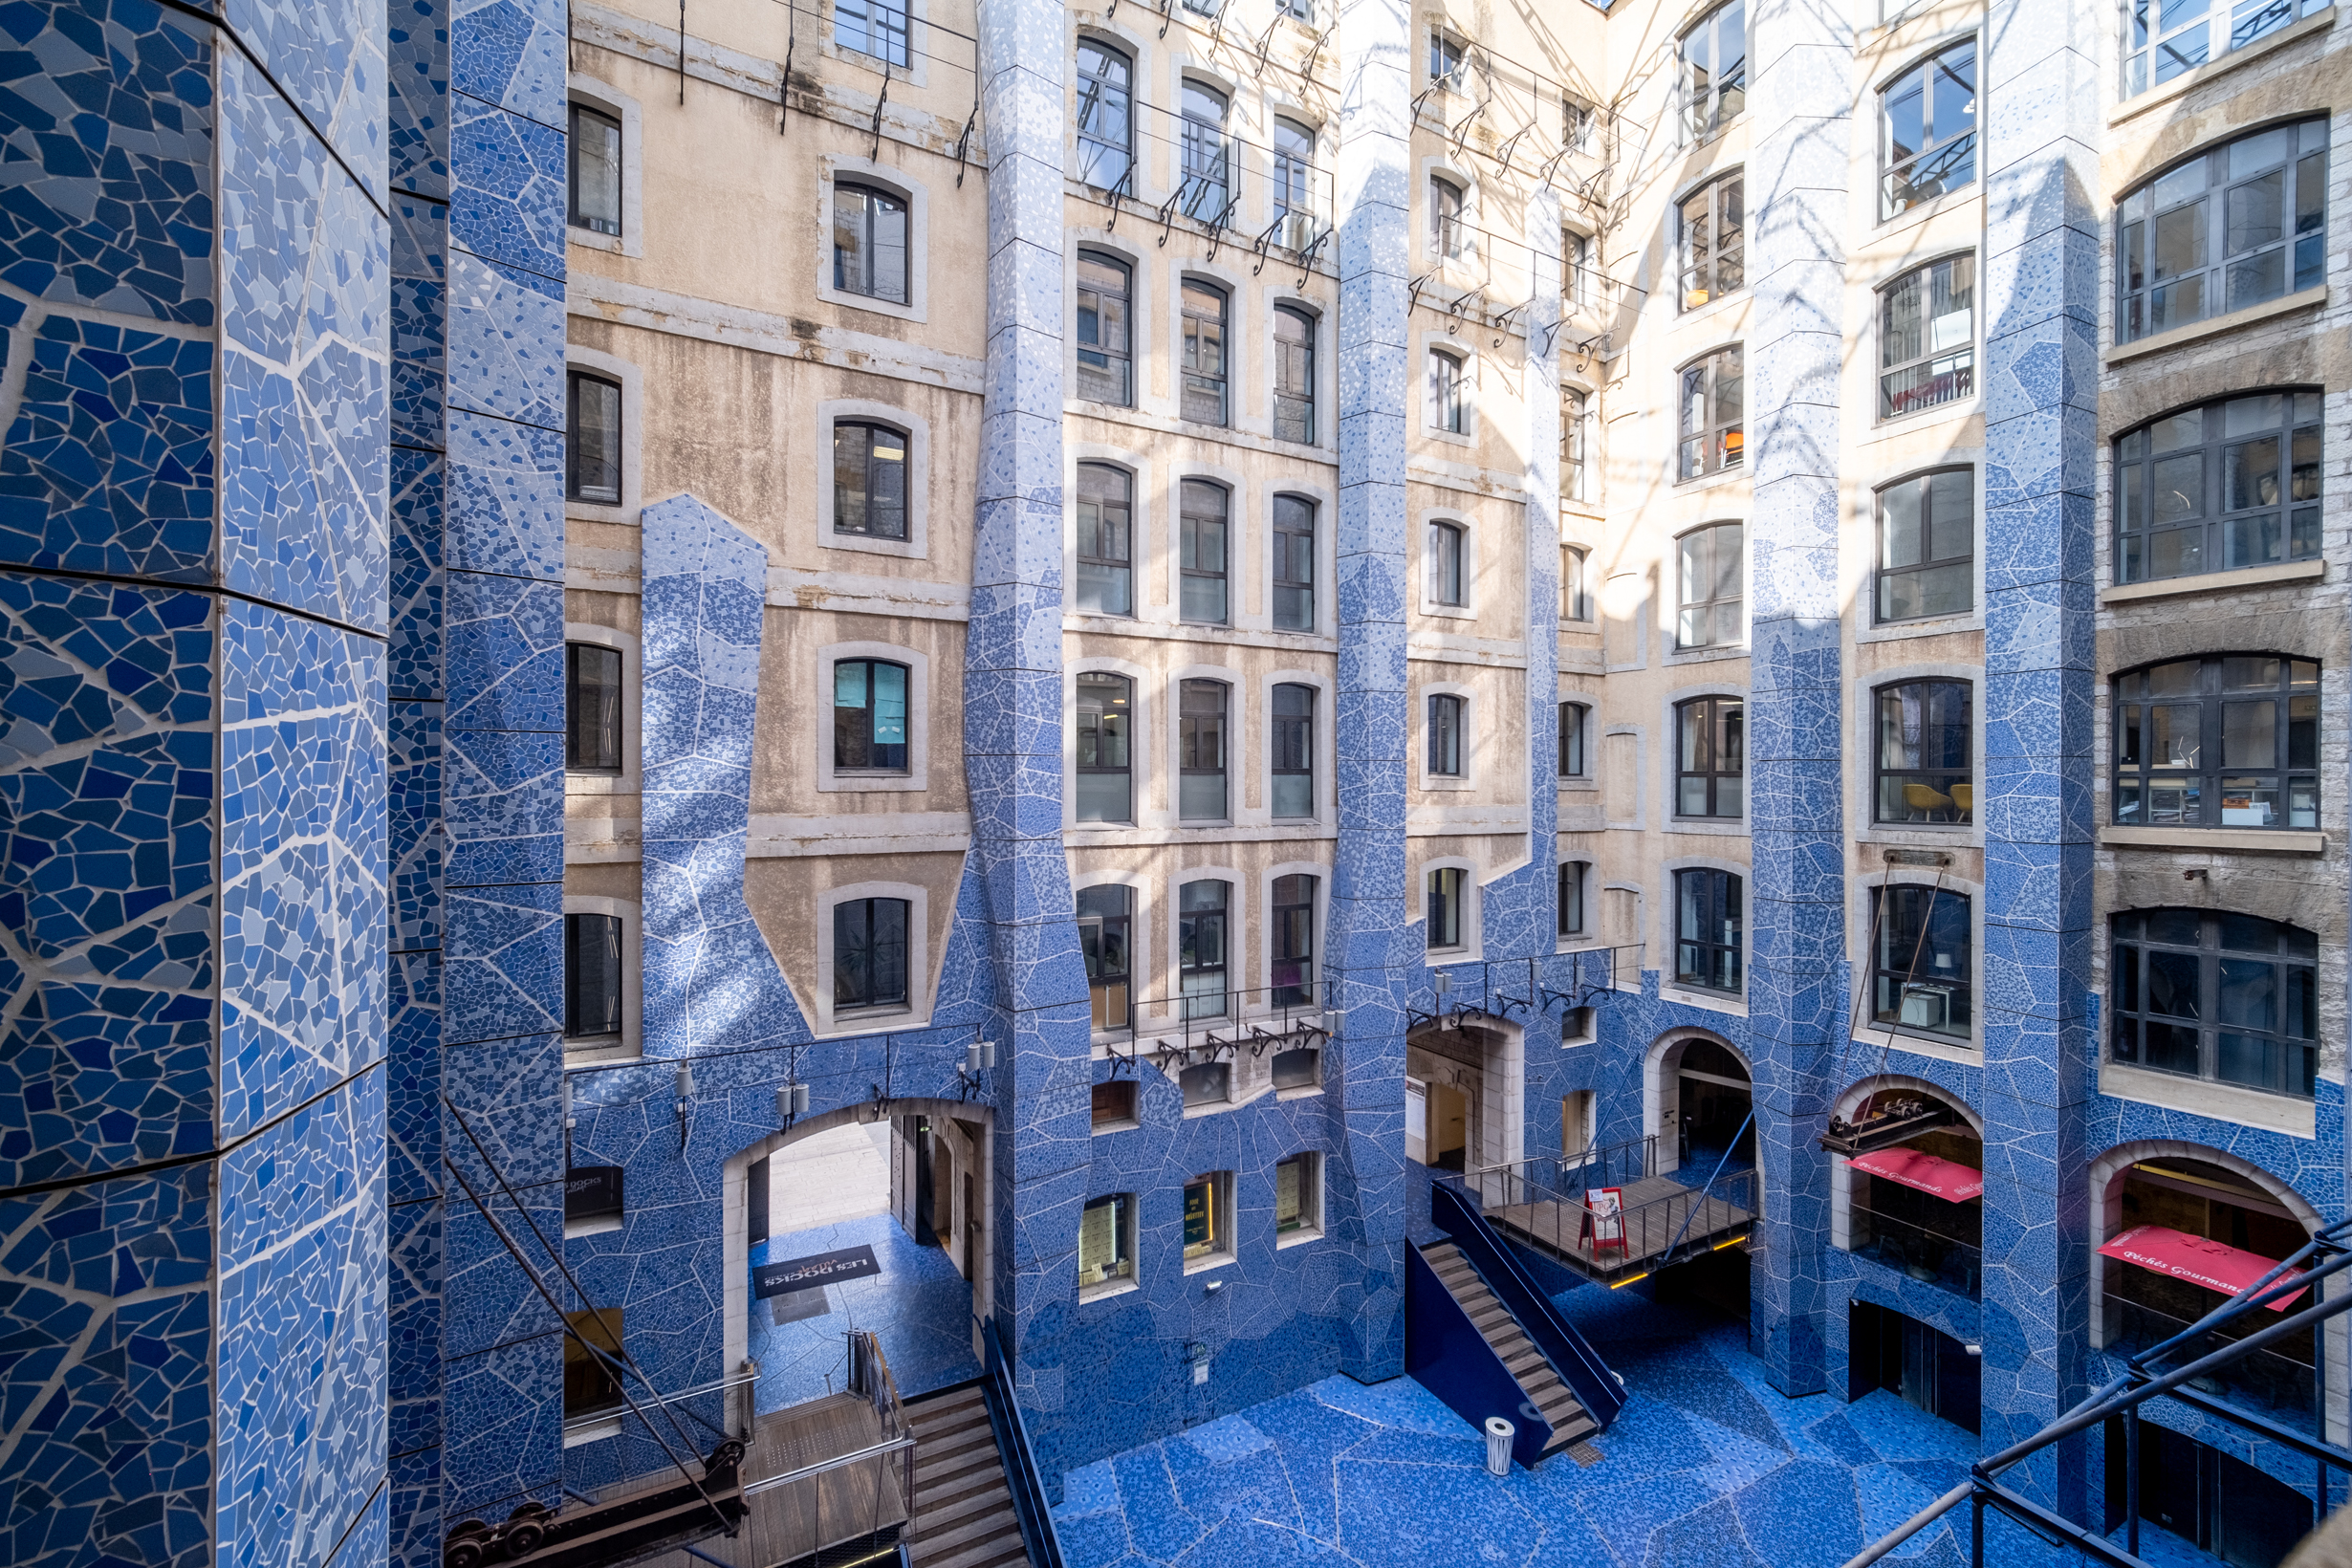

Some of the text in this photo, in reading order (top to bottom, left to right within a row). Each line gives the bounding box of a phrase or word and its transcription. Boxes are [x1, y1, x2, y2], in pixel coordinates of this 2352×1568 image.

[570, 1177, 602, 1187] DOCKS
[1887, 1172, 1943, 1192] Gourmands
[2123, 1251, 2167, 1269] Péchés
[765, 1258, 868, 1287] LES DOCKS
